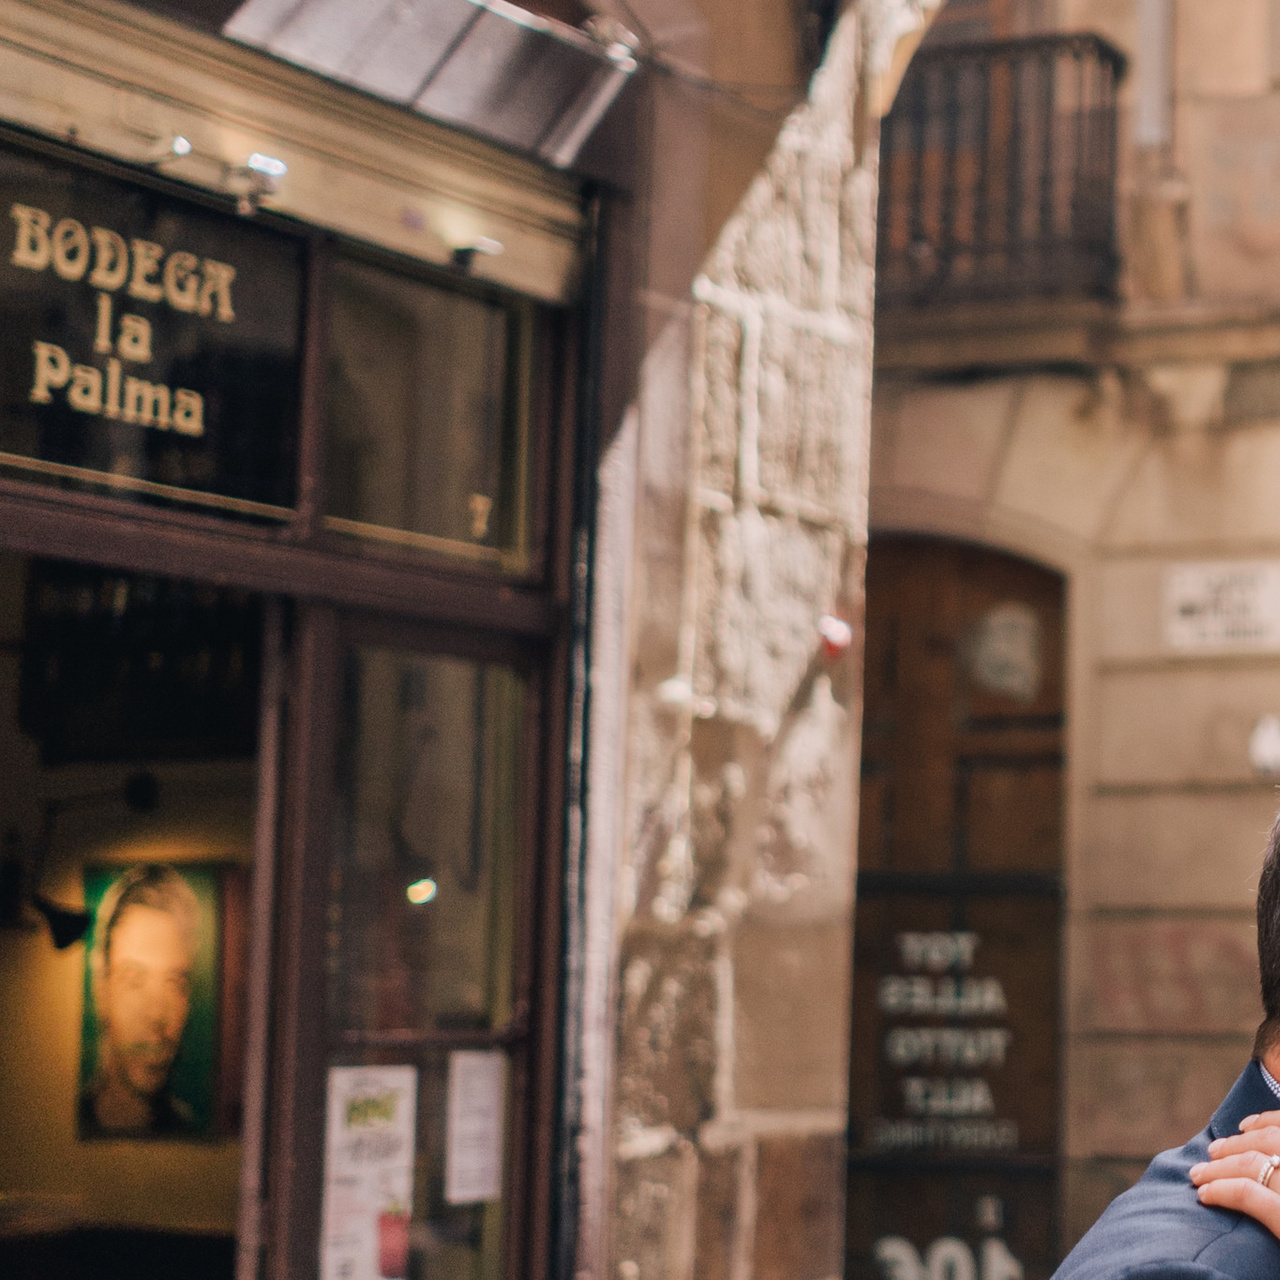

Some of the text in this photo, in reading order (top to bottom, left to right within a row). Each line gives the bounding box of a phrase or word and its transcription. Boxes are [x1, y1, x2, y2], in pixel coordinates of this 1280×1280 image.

[11, 202, 236, 323] BODEGA
[94, 292, 152, 363] la
[30, 340, 204, 437] Palma
